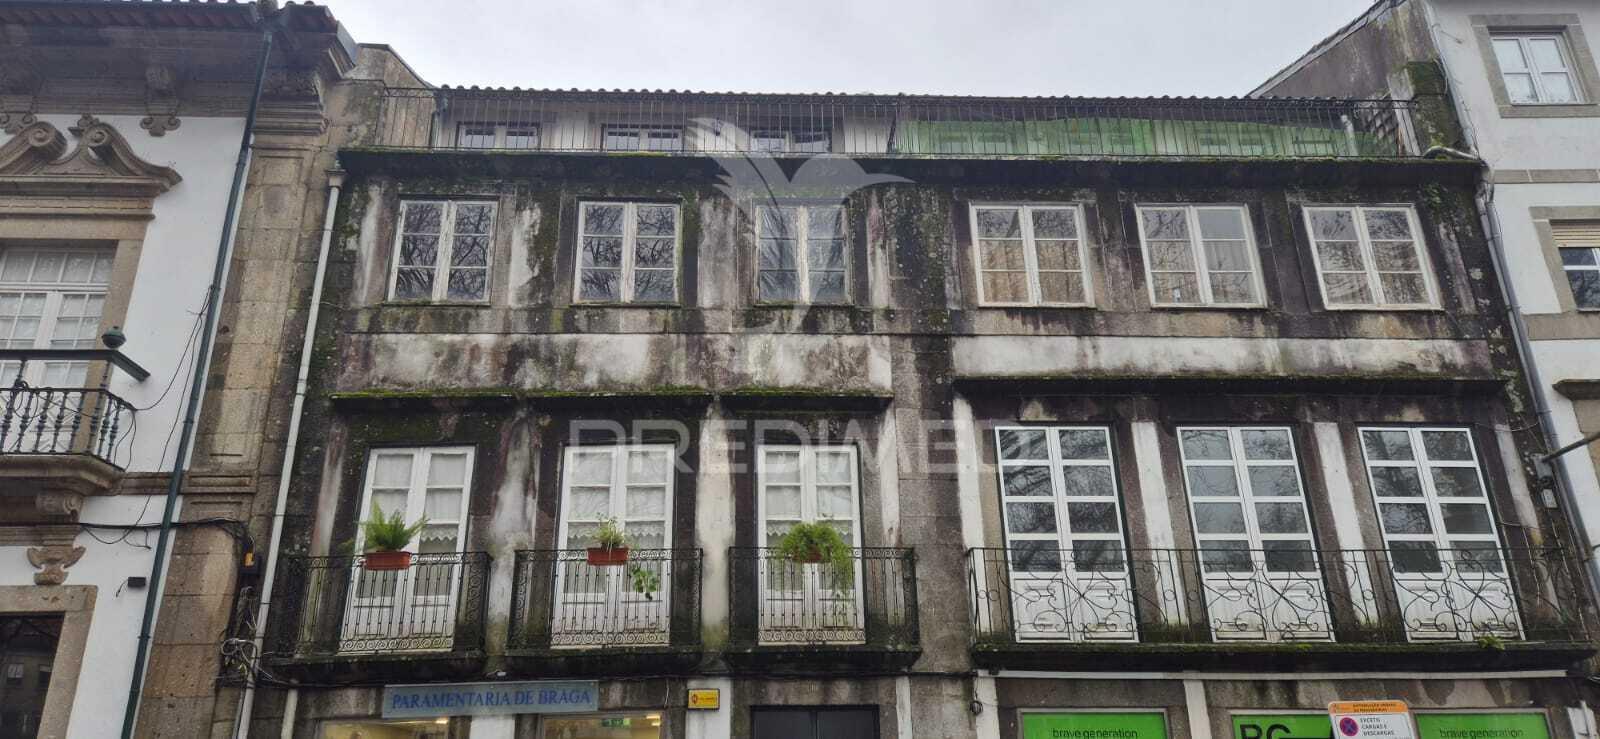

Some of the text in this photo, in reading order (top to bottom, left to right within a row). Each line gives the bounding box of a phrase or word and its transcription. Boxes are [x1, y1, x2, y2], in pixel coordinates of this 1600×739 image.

[391, 689, 591, 709] PARAMENTARIA DE BRAGA
[1052, 728, 1138, 739] brave generation
[1440, 728, 1523, 739] brave generation
